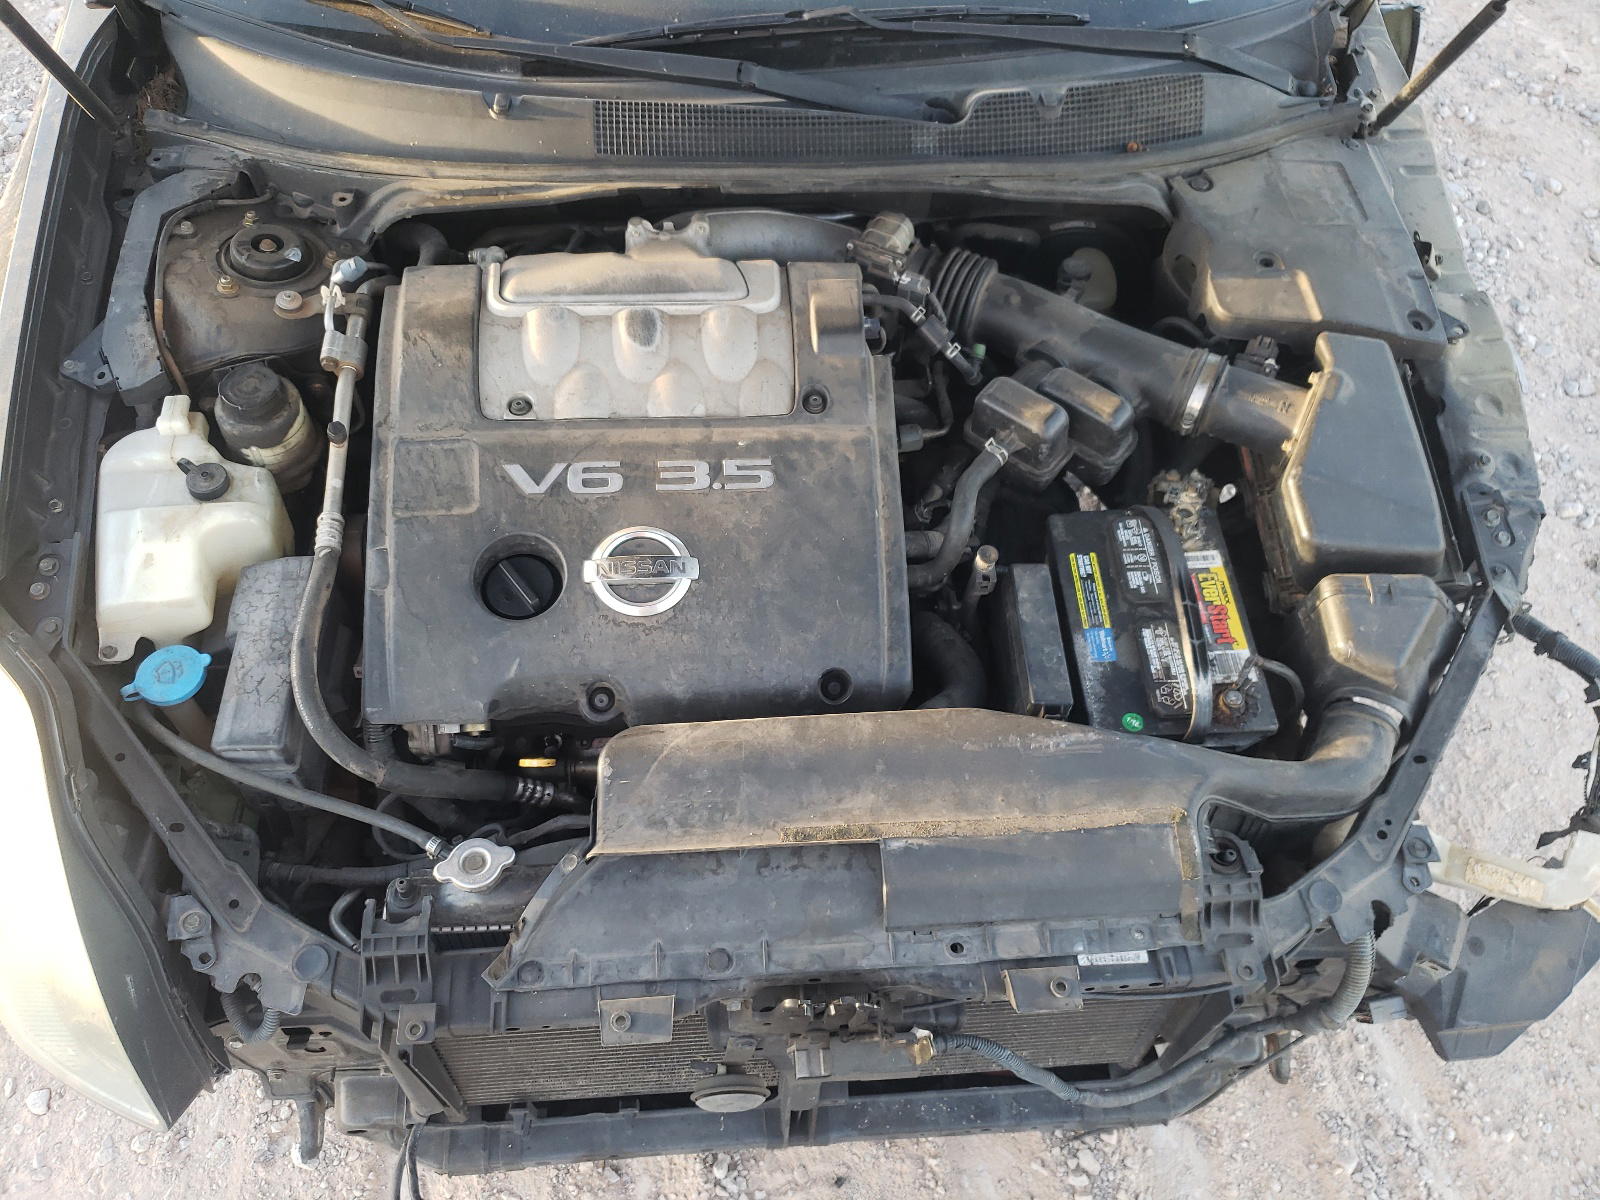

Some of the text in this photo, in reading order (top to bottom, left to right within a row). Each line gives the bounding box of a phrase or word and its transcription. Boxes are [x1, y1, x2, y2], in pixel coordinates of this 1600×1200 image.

[503, 459, 775, 494] V6 3.5
[597, 560, 686, 577] NISSAN
[1198, 573, 1236, 645] EverStart
